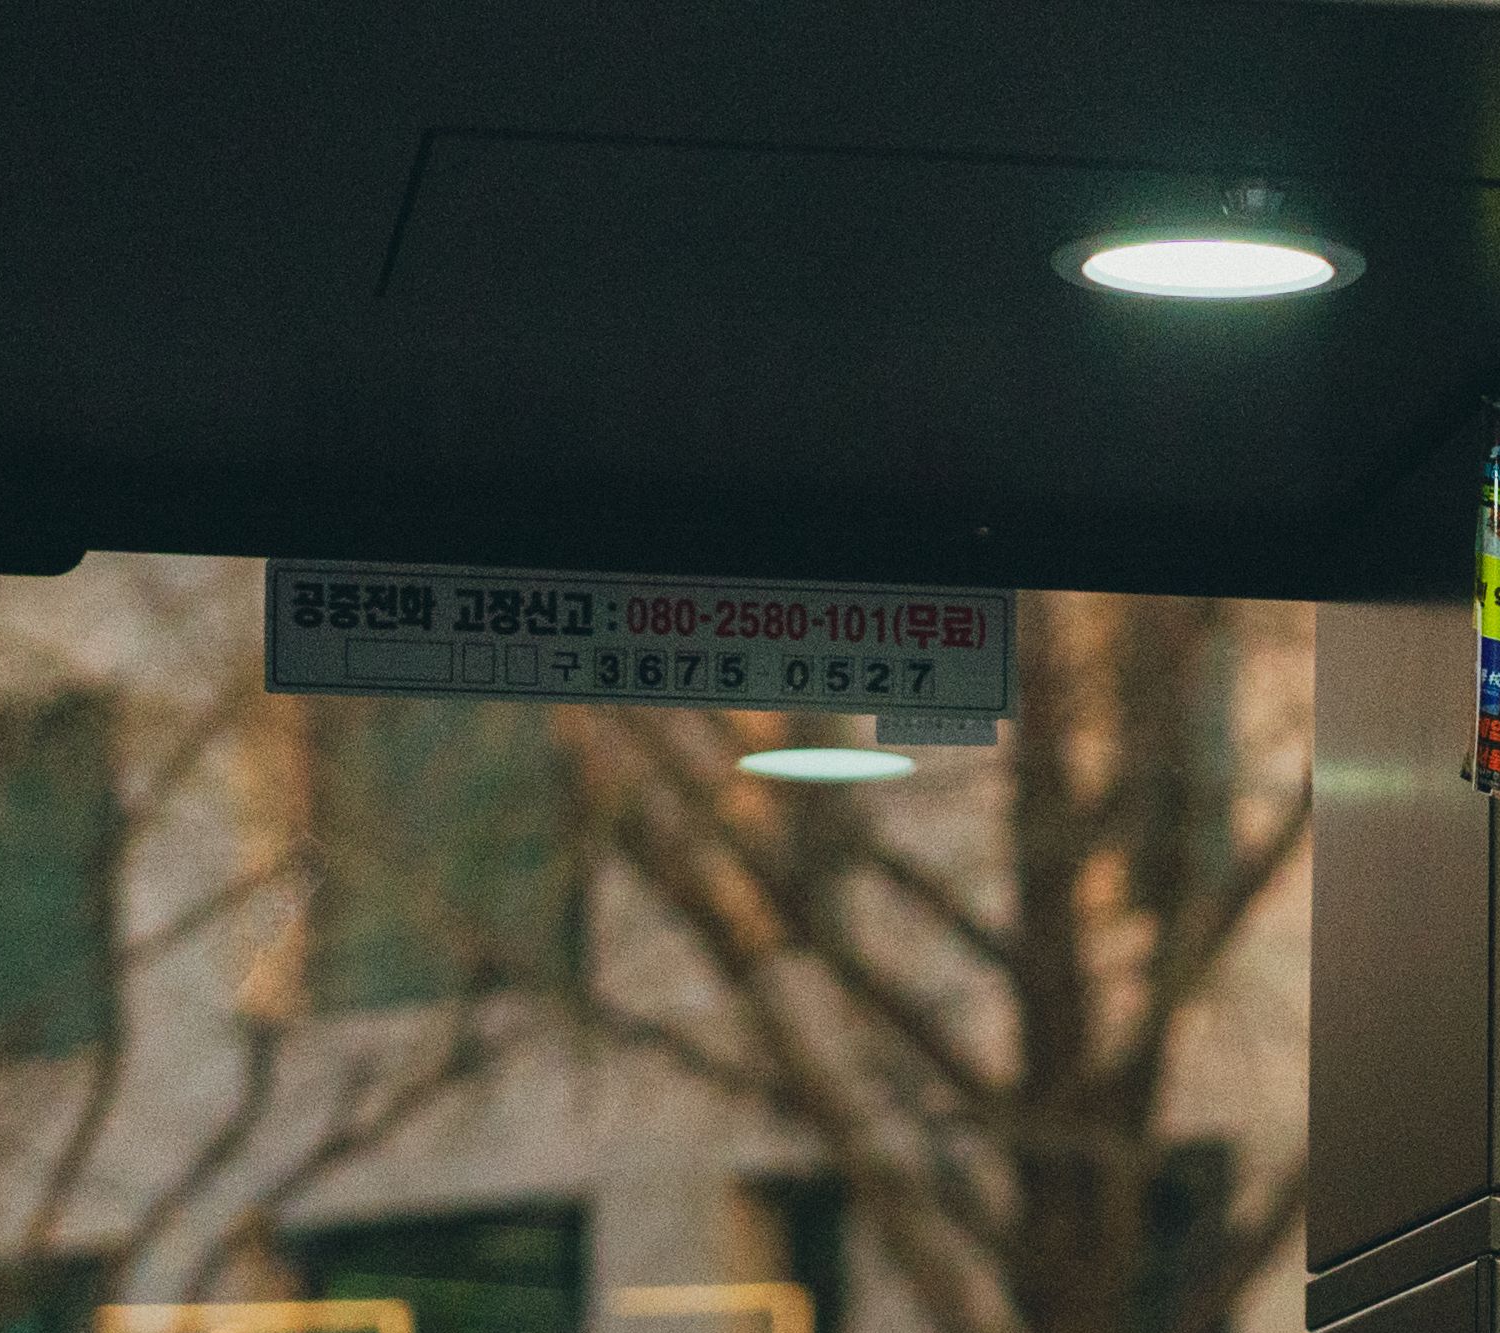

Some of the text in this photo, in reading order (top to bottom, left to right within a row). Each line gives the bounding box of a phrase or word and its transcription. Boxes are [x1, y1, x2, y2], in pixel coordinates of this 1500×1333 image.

[295, 581, 435, 631] 공중전화
[601, 654, 746, 688] 3675
[786, 660, 935, 695] 0527
